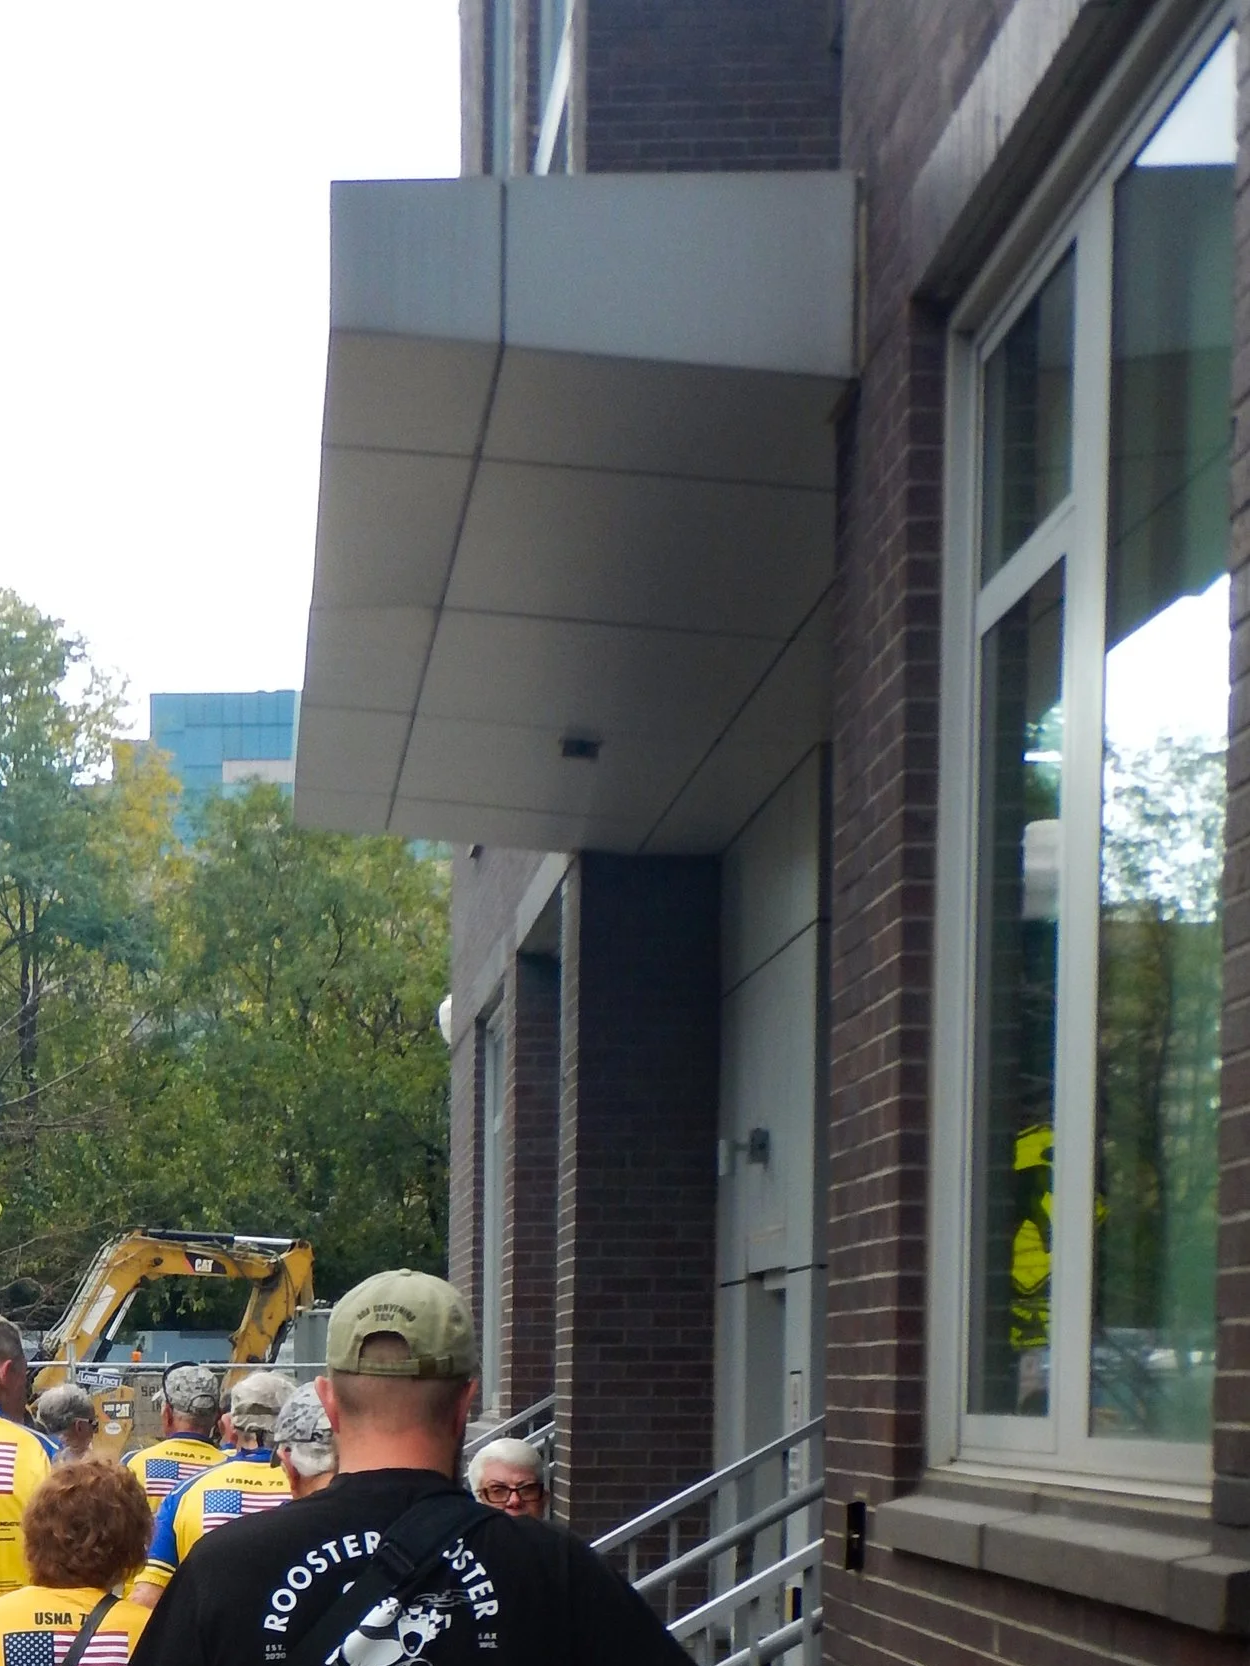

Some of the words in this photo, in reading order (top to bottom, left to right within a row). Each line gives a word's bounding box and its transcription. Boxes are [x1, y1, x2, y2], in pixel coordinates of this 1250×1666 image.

[195, 1258, 213, 1272] CAT
[80, 1372, 100, 1383] LONG
[99, 1375, 119, 1387] FENCE
[165, 1451, 196, 1459] USNA
[226, 1477, 263, 1486] USNA
[264, 1531, 381, 1633] ROOSTER
[34, 1612, 73, 1625] USNA
[78, 1613, 90, 1626] 7
[265, 1652, 287, 1660] 2020
